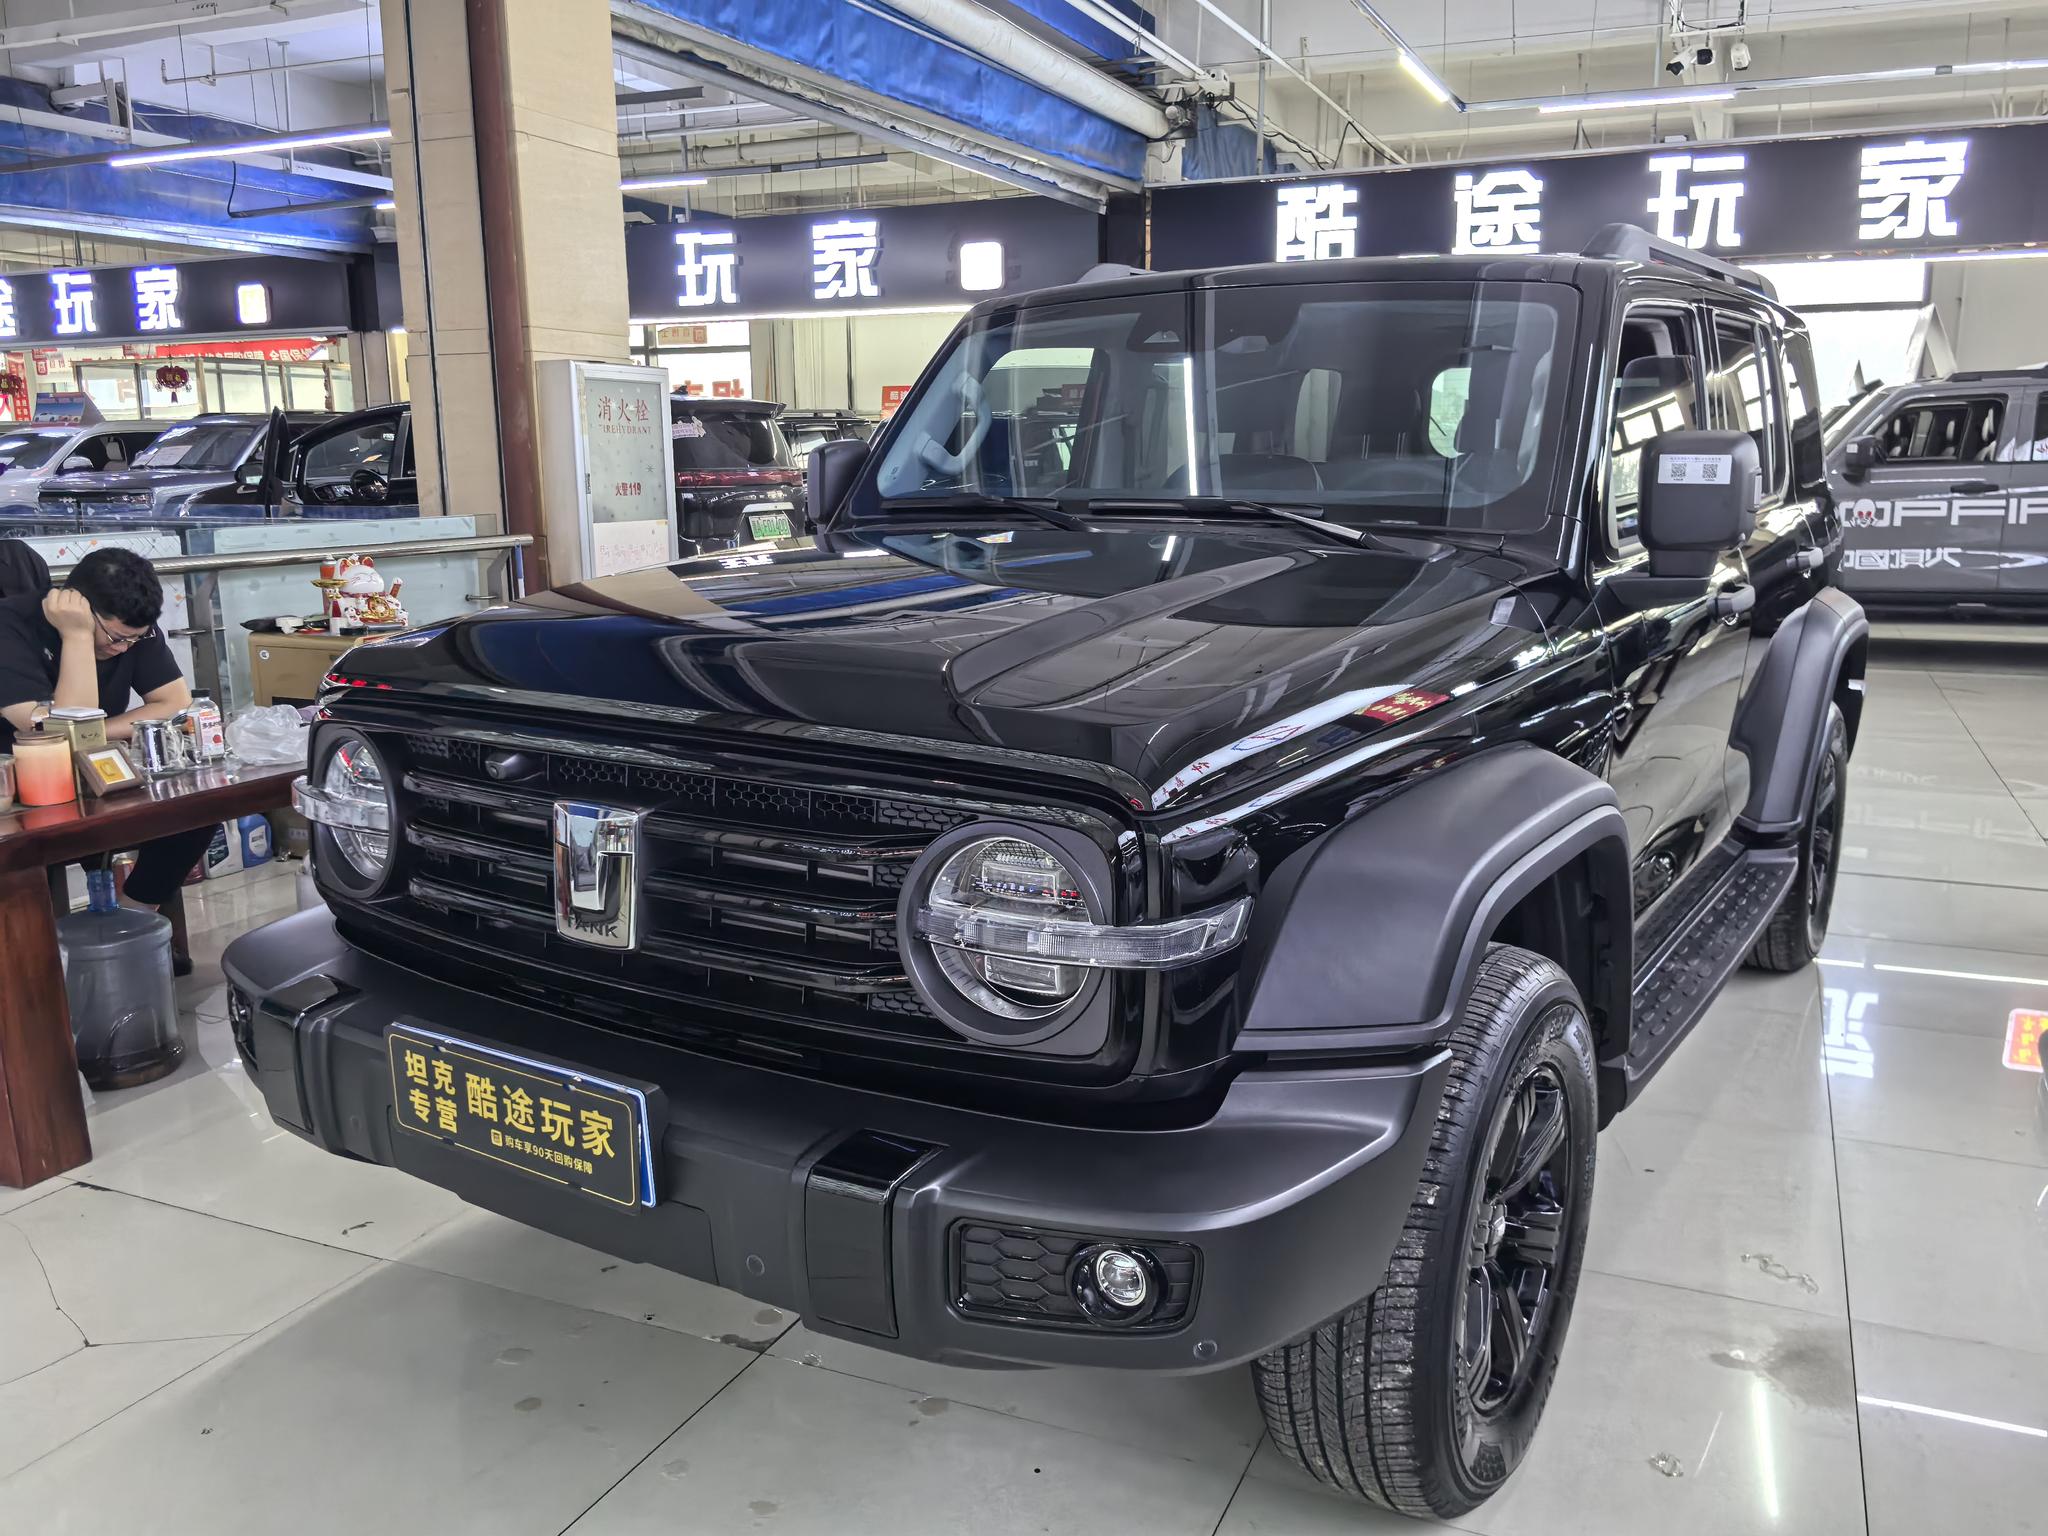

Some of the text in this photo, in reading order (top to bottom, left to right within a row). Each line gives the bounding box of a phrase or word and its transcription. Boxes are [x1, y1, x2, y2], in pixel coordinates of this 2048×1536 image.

[1276, 140, 1968, 262] 酷途玩家
[675, 220, 880, 307] 玩家
[598, 396, 649, 423] 消火栓
[568, 916, 618, 938] TANK
[404, 1049, 456, 1097] 坦克
[409, 1088, 458, 1133] 专营
[464, 1072, 616, 1158] 酷途玩家
[504, 1134, 594, 1175] 购车享90天回购保障
